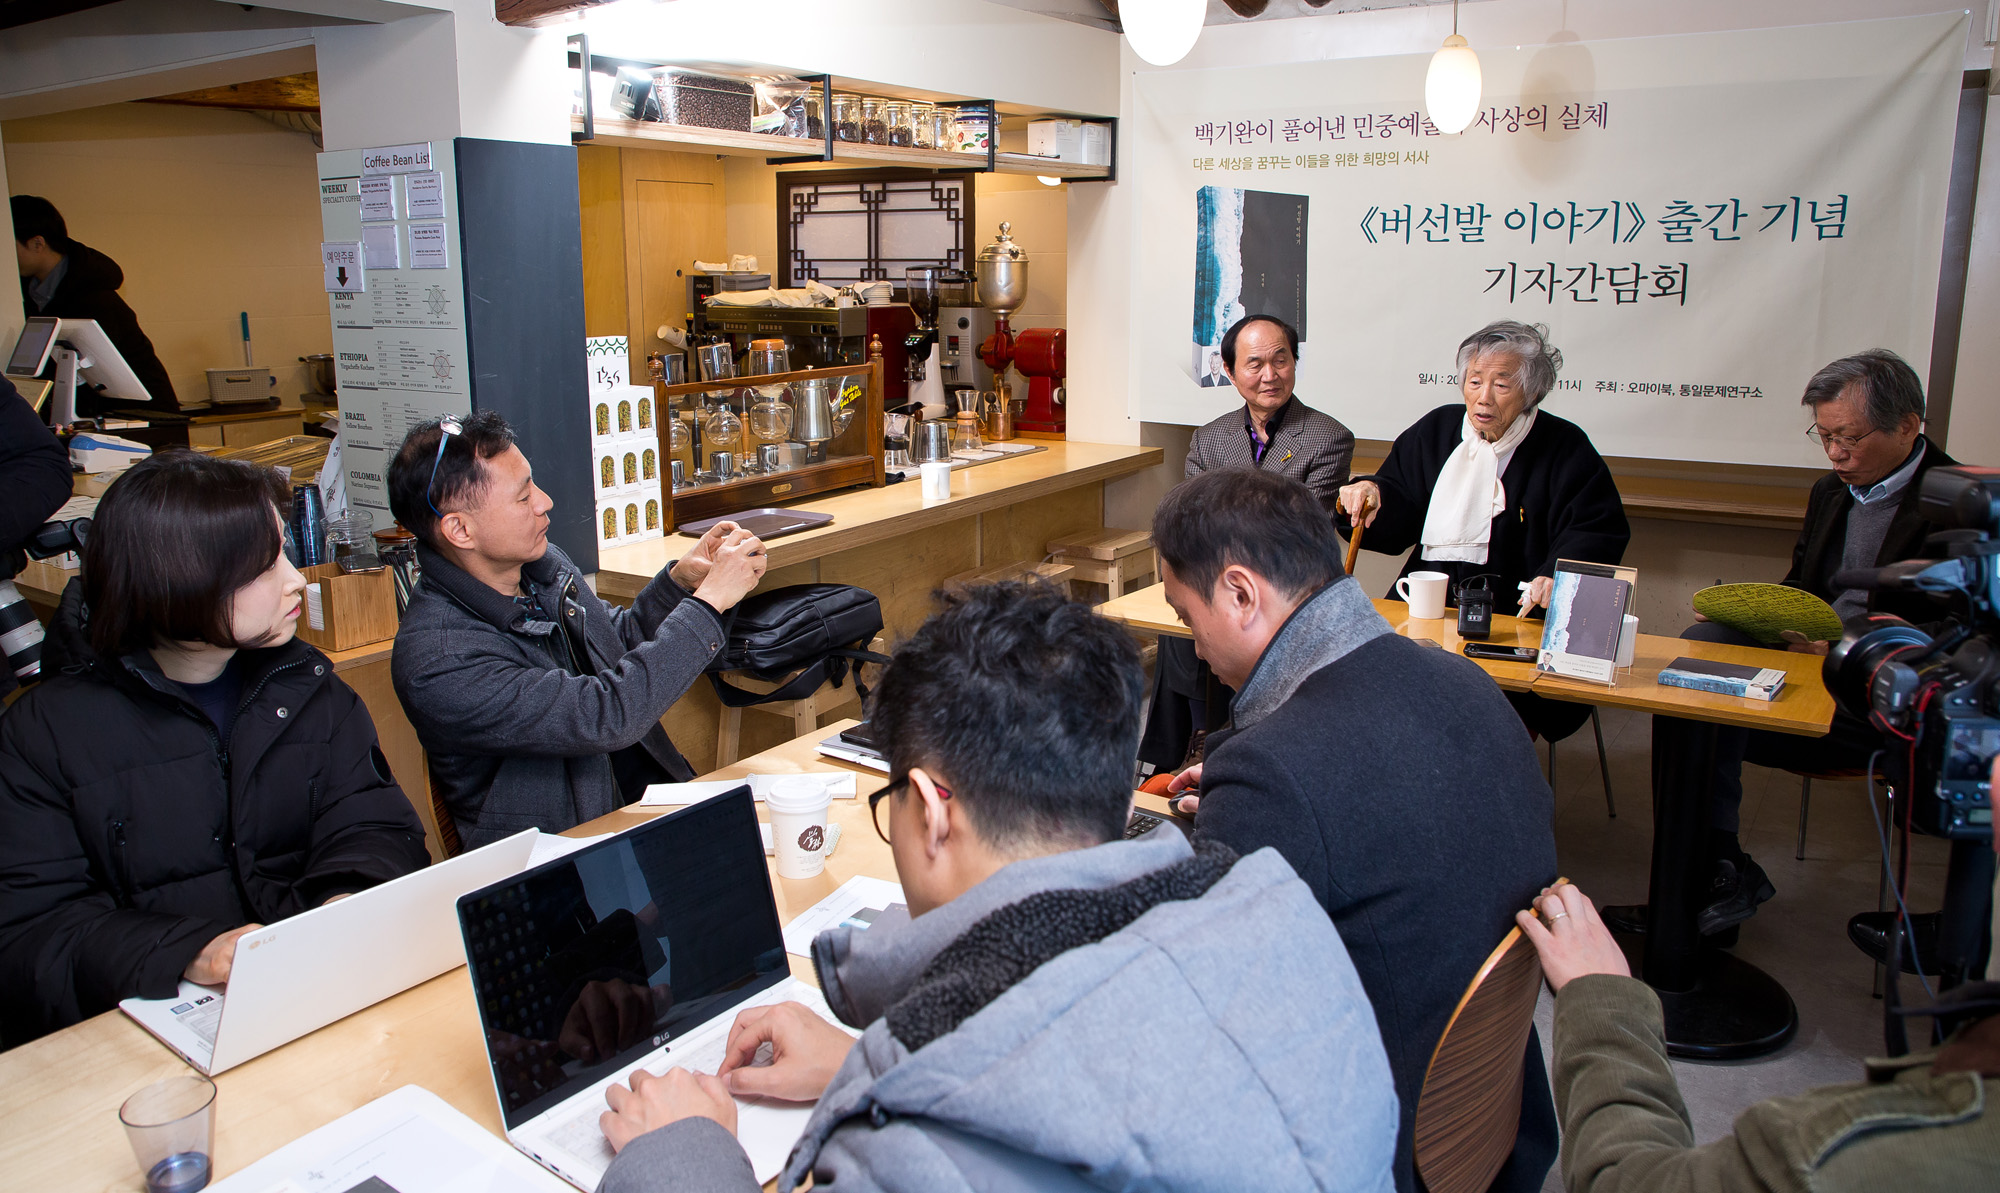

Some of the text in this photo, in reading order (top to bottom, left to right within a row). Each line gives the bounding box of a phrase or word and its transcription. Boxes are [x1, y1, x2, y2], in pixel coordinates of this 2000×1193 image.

[1195, 119, 1274, 146] 백기완이
[1281, 115, 1346, 142] 풀어낸
[1475, 104, 1548, 135] 사상의
[1558, 101, 1608, 130] 실체
[364, 152, 430, 168] Coffee Bean List
[1193, 150, 1429, 171] 다른 세상을 꿈꾸는 이들을 위한 희망의 서사
[321, 184, 348, 194] WEEKLY
[322, 196, 345, 204] SPECIALTY
[1360, 194, 1849, 245] 《버선발 이야기》 출간 기념
[327, 251, 355, 264] 예약주문
[1482, 261, 1689, 307] 기자간담회
[335, 292, 354, 301] KENYA
[340, 352, 368, 362] ETHIOPIA
[597, 366, 620, 390] 1956
[1418, 372, 1438, 385] 일시
[1558, 379, 1582, 392] 11시
[1595, 380, 1618, 393] 주최
[1627, 382, 1675, 397] 오마이북,
[1679, 384, 1764, 399] 통일문제연구소
[345, 412, 366, 421] BRAZIL
[350, 471, 381, 482] COLOMBIA
[263, 935, 276, 944] LG
[661, 1032, 670, 1042] LG
